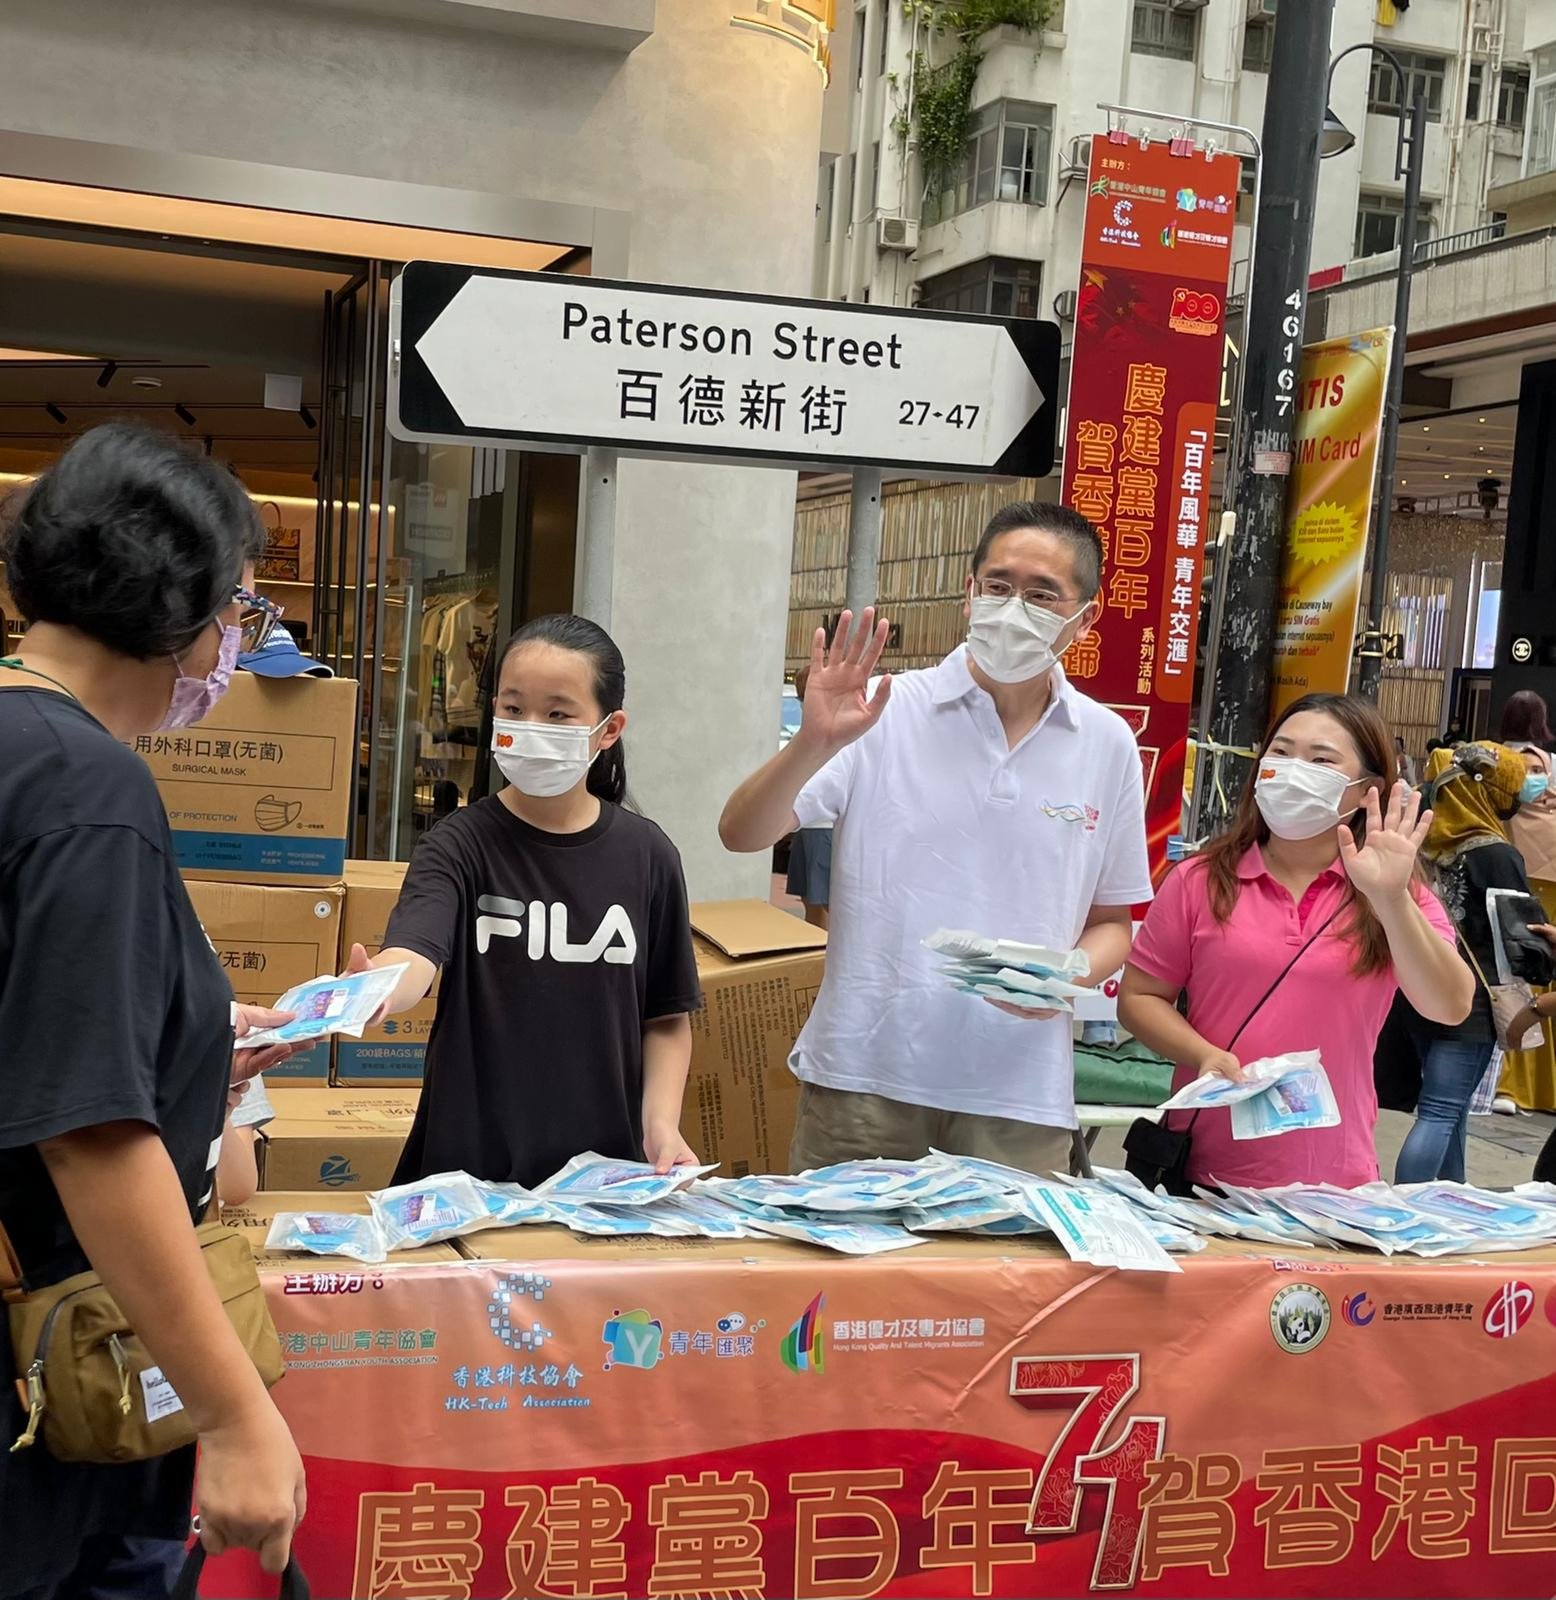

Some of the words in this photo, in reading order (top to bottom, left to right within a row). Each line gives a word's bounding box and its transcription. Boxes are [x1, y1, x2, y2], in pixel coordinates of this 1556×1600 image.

[562, 302, 752, 356] Paterson
[773, 321, 902, 369] Street
[1275, 289, 1301, 416] 46167
[617, 368, 847, 436] 百德新街
[1320, 432, 1361, 462] Card
[1108, 363, 1167, 619] 慶建黨百年
[1295, 600, 1321, 612] Causeway
[1322, 598, 1333, 612] bay
[1136, 627, 1155, 695] 系列活動
[122, 735, 284, 764] 用外科口罩(无菌)
[172, 763, 218, 775] SURGICAL
[221, 767, 247, 776] MASK
[169, 811, 182, 820] OF
[184, 812, 238, 823] PROTECTION
[476, 894, 637, 965] FILA
[402, 1020, 413, 1034] 3
[833, 1343, 850, 1352] Hong
[852, 1343, 867, 1352] Kong
[868, 1342, 889, 1351] Quality
[925, 1341, 950, 1349] Migrants
[445, 1396, 508, 1410] HK-Tech
[523, 1394, 591, 1409] Association
[354, 1460, 1038, 1600] 慶建黨百年
